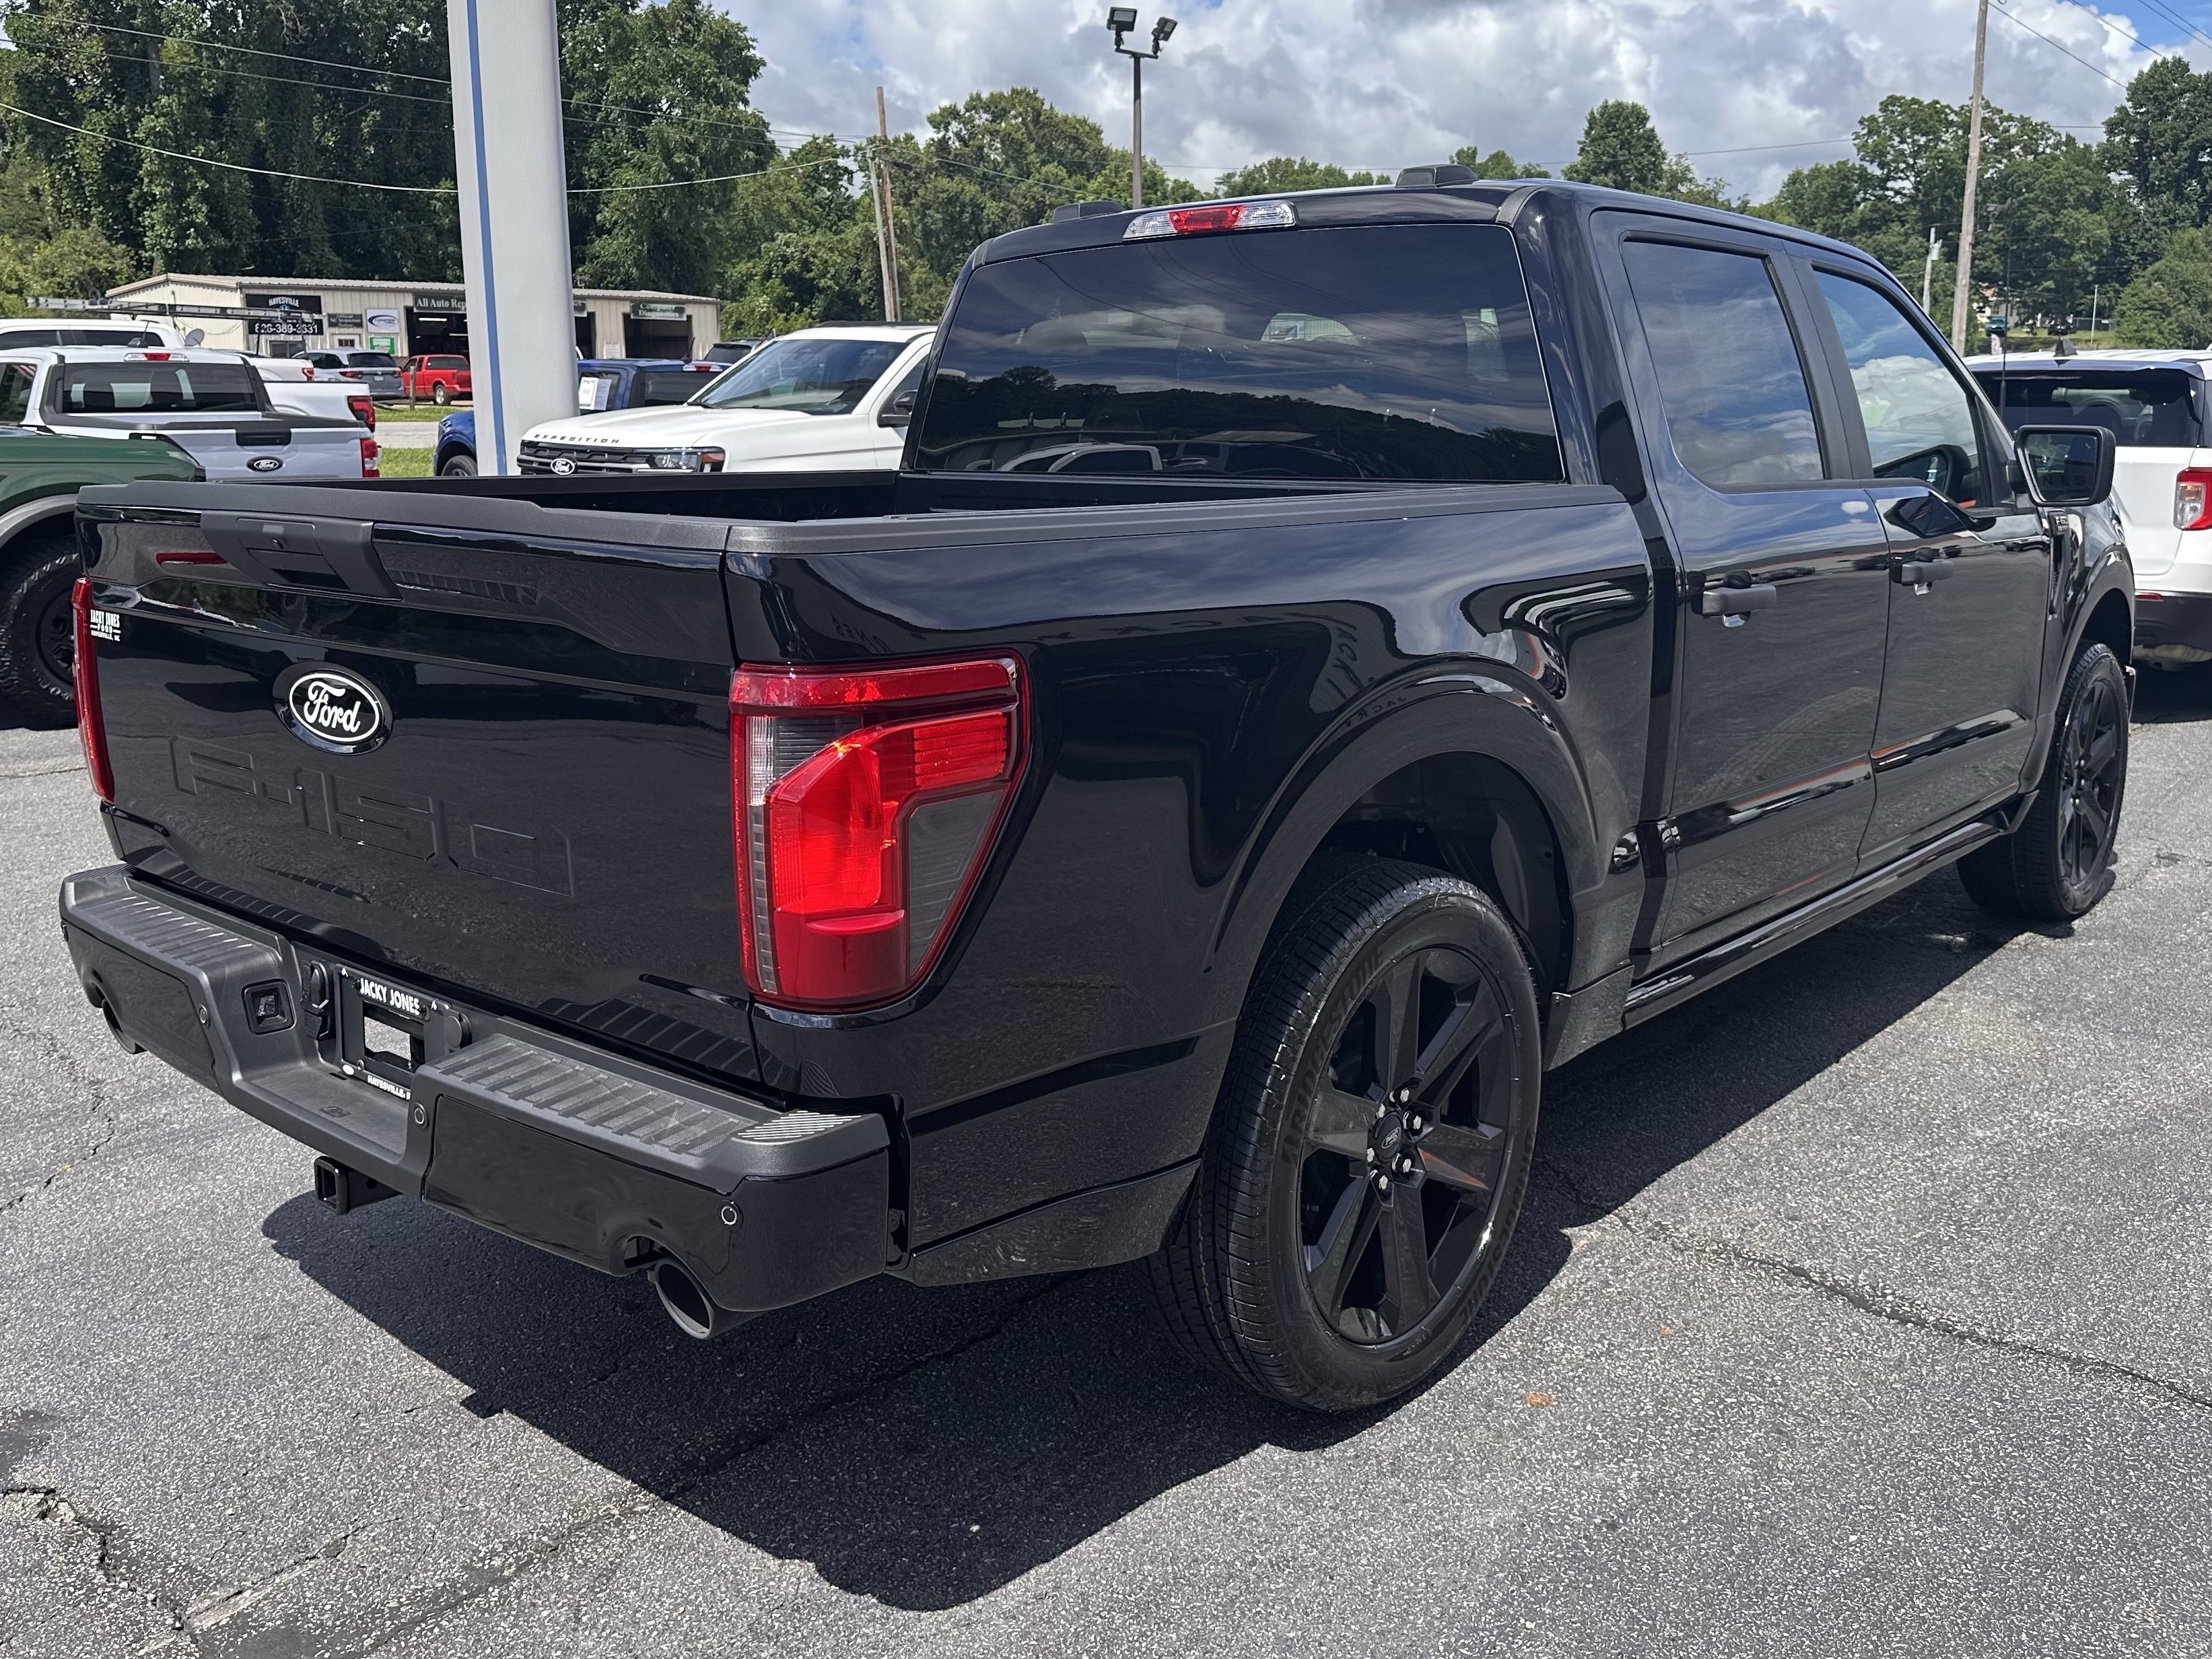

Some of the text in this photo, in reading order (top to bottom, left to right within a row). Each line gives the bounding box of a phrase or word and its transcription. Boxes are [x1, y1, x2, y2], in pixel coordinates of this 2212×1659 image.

[269, 296, 300, 307] HAYESVILLE
[417, 298, 428, 307] All
[430, 298, 450, 308] Auto
[534, 434, 619, 444] EXPEDITION
[90, 609, 120, 628] JACKY JONES
[97, 623, 113, 634] FORD
[304, 681, 361, 733] Ford
[359, 978, 420, 1016] JACKY JONES
